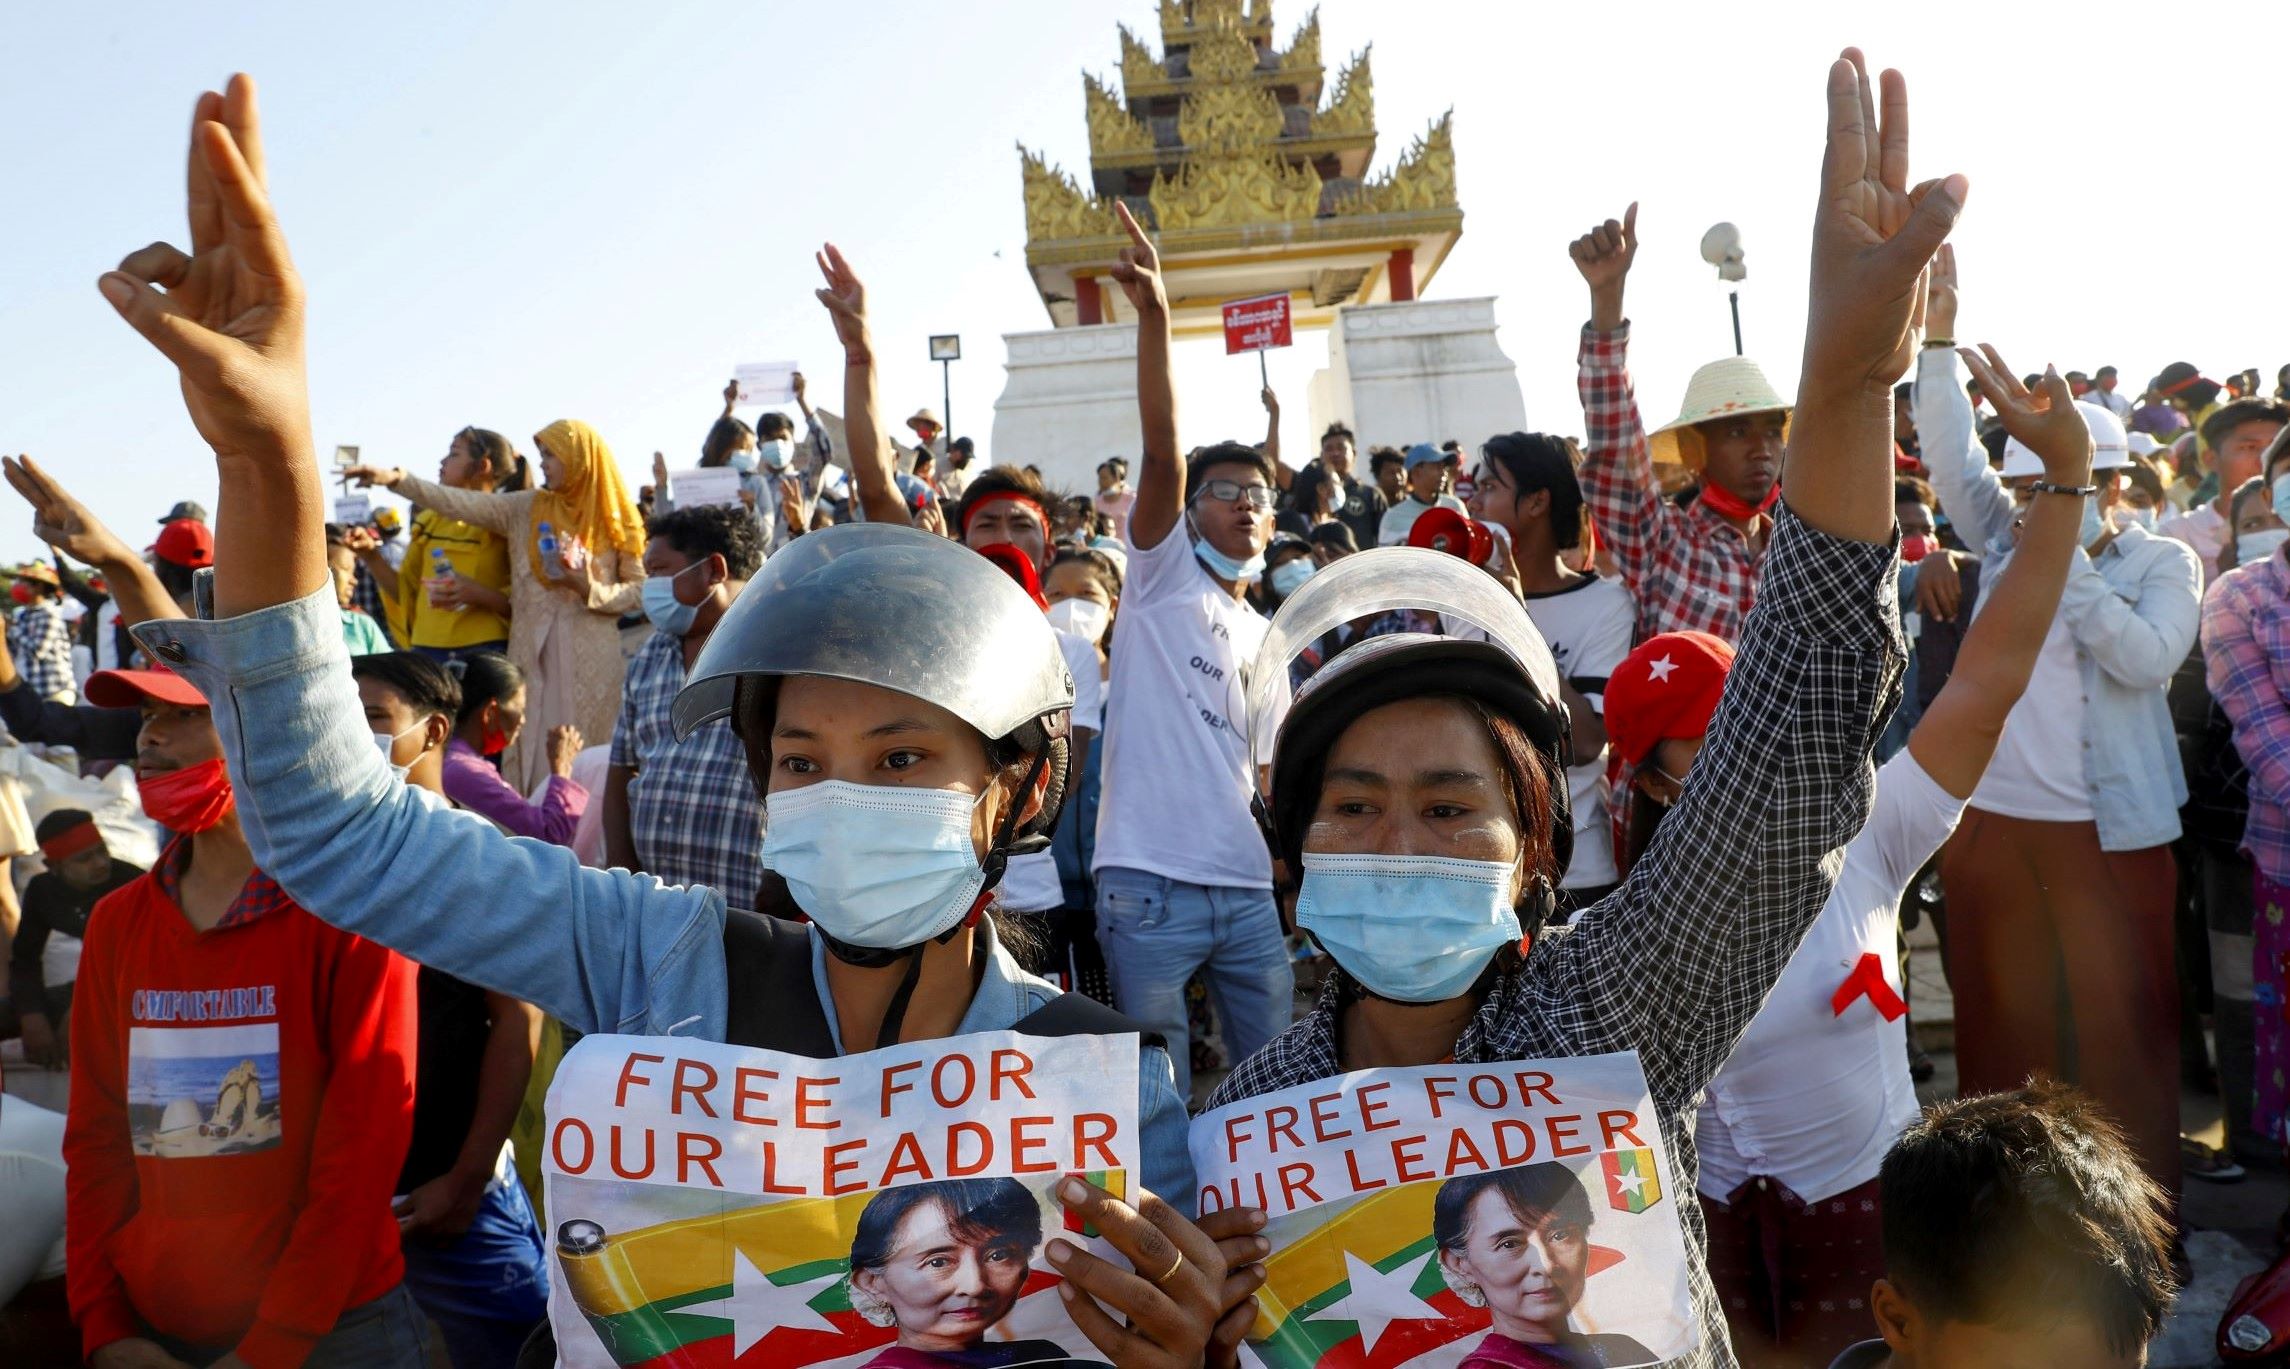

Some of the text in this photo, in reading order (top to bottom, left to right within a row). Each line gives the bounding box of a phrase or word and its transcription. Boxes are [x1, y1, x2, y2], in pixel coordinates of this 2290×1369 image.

[1189, 656, 1224, 681] OUR
[614, 1049, 1036, 1131] FREE FOR
[1225, 1071, 1563, 1163] FREE FOR
[551, 1112, 1121, 1196] OUR LEADER
[1344, 1109, 1646, 1193] LEADER
